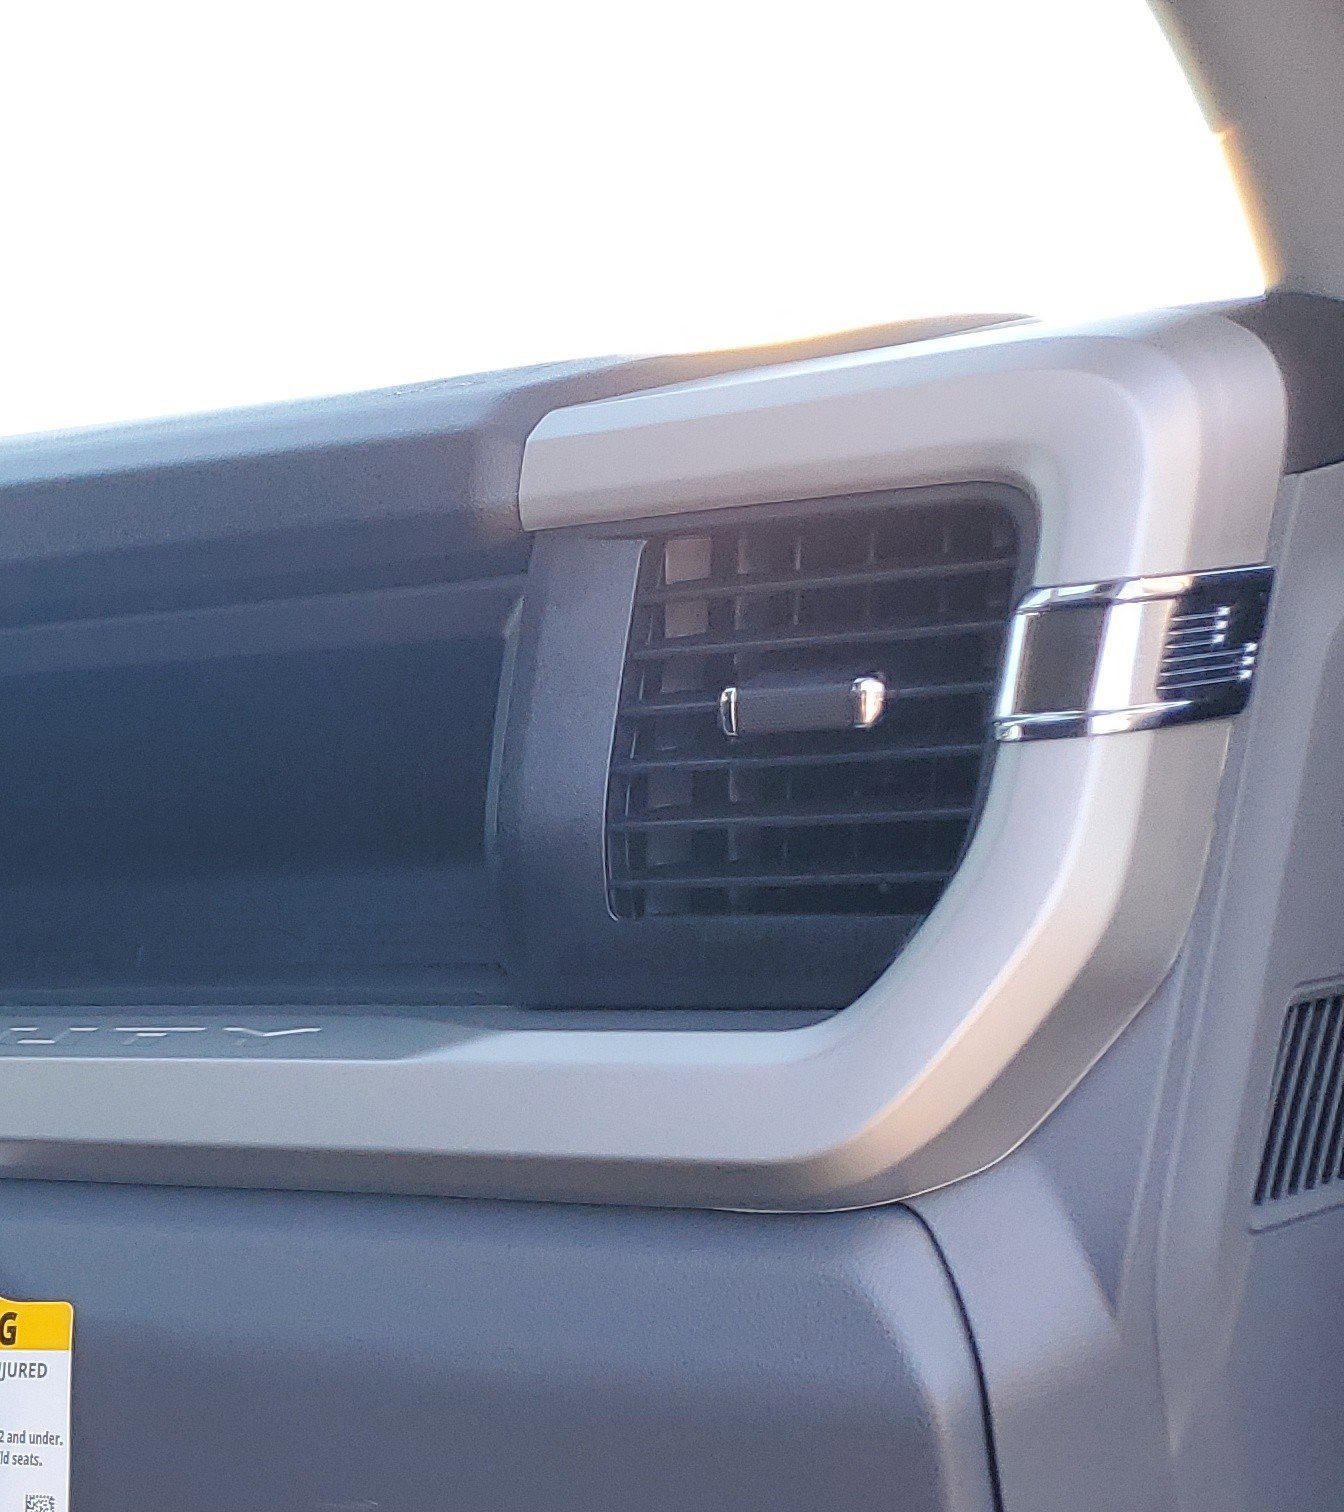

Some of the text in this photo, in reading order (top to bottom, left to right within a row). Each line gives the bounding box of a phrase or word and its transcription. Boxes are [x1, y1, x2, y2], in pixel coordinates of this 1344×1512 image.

[6, 1430, 26, 1444] and
[29, 1431, 63, 1446] under.
[12, 1454, 43, 1467] seats.
